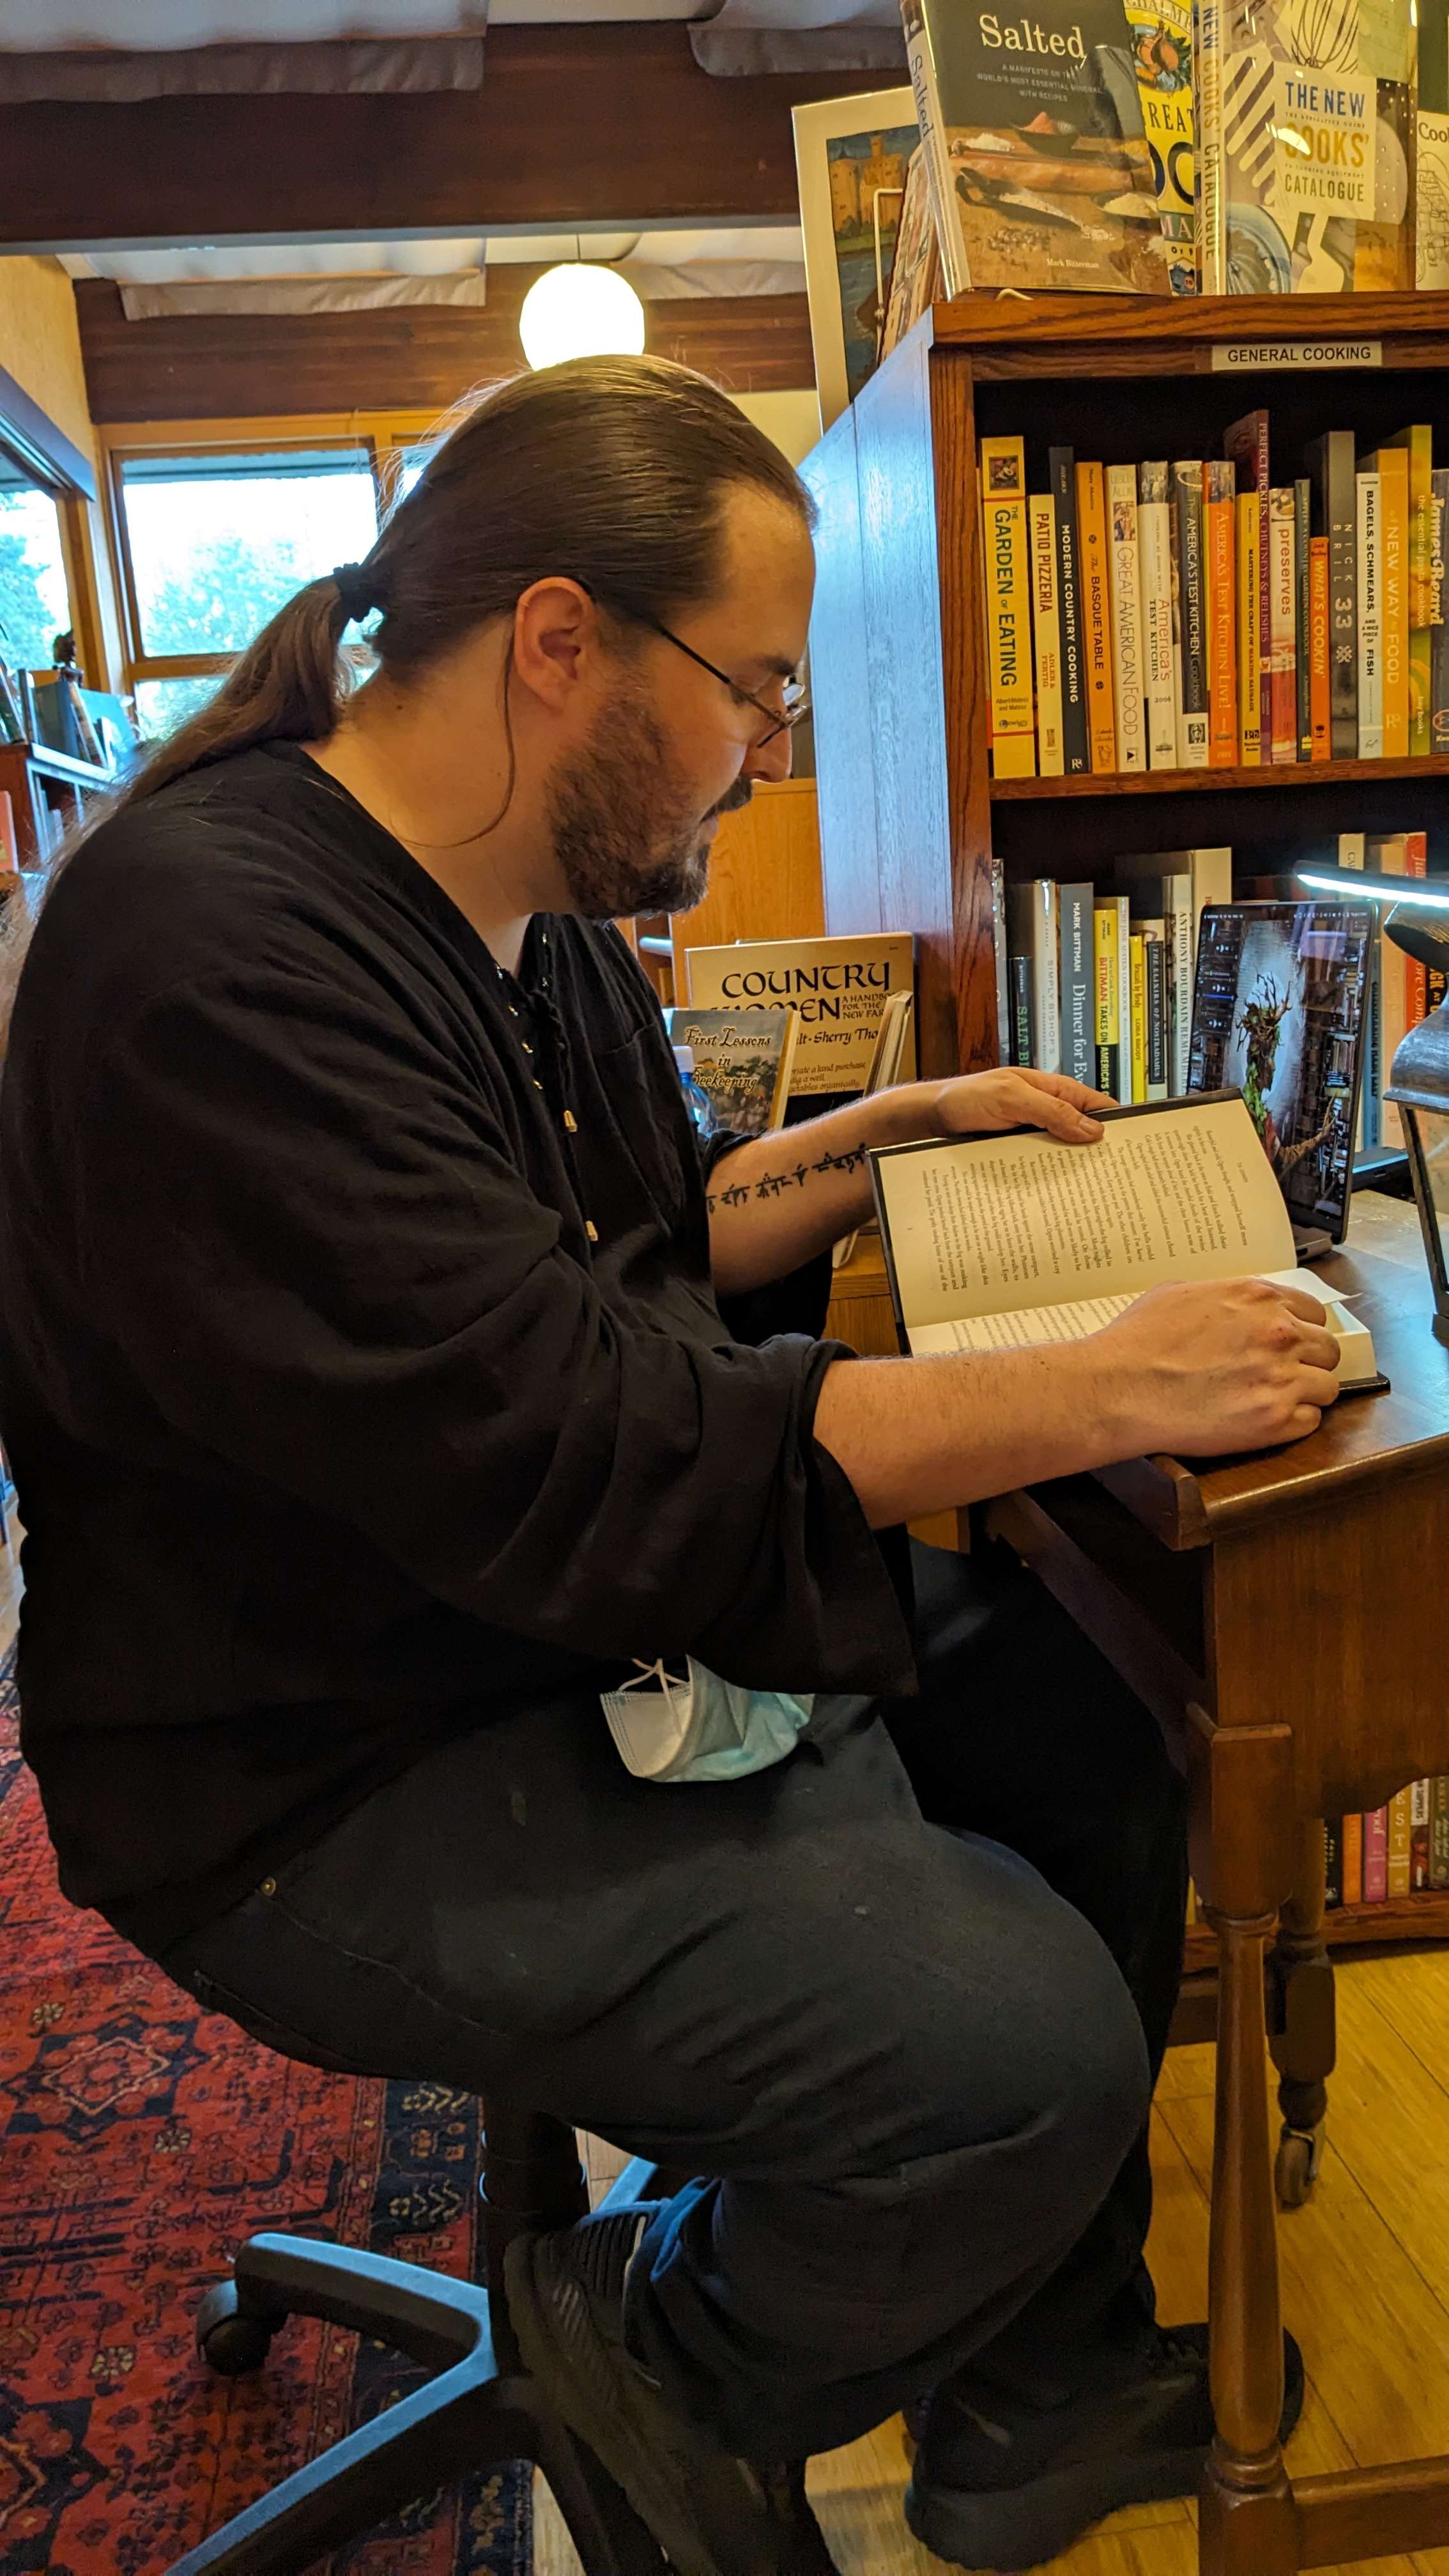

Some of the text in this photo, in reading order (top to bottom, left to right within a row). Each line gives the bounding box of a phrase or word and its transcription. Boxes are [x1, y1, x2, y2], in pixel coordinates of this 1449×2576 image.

[979, 14, 1085, 59] Salted
[1203, 7, 1218, 50] NEW
[976, 73, 1008, 83] WORLD'S
[1031, 79, 1070, 91] ESSENTIAL
[1009, 65, 1049, 76] MANIFESTO
[910, 55, 934, 137] Salted
[1019, 90, 1068, 102] WITH RECIPES
[1285, 81, 1365, 118] THE NEW
[1418, 122, 1449, 143] Coo
[1204, 143, 1221, 261] CATALOGUE
[1285, 173, 1365, 203] CATALOGUE
[1046, 258, 1100, 269] Mark Bitterman
[1227, 346, 1372, 362] GENERAL COOKING
[1011, 506, 1019, 521] THE
[1366, 490, 1375, 540] BAGELS,
[1259, 423, 1269, 643] PERFECT PICKLES, CHUTNEYS & RELISHES
[995, 509, 1014, 595] GARDEN
[1036, 513, 1053, 613] PATIO PIZZERIA
[1415, 494, 1427, 627] the essential pasta cookbook
[1430, 493, 1445, 625] James Beard
[1278, 528, 1291, 615] preserves
[1314, 561, 1325, 611] WHAT'S
[1367, 543, 1375, 613] SCHMEARS,
[1000, 600, 1008, 610] OF
[1061, 525, 1079, 703] MODERN COUNTRY COOKING
[1091, 576, 1102, 628] BASQUE
[1186, 518, 1200, 710] AMERICA'S TEST KITCHEN Cookbook
[1216, 512, 1231, 708] AMERICA'S TEST KITCHEN LIVE!
[1335, 597, 1353, 629] 33
[1387, 526, 1400, 684] NEW WAY FOOD
[998, 613, 1018, 686] EATING
[1094, 630, 1104, 670] TABLE
[1117, 547, 1139, 735] GREAT AMERICAN FOOD
[1158, 599, 1172, 680] America's
[1249, 636, 1254, 645] OF
[1314, 615, 1326, 678] COOKIN'
[1151, 632, 1159, 682] KITCHEN
[1073, 901, 1081, 930] MARK
[1073, 932, 1082, 972] BITTMAN
[1179, 911, 1188, 963] ANTHONY
[721, 962, 889, 998] COUNTRY
[1180, 967, 1189, 1023] BOURDAIN
[1433, 992, 1441, 1002] AT
[843, 1009, 884, 1020] NEW FAR
[850, 993, 890, 1002] HANDBO
[1073, 983, 1087, 1036] Dinner
[1133, 993, 1143, 1008] Brody
[1154, 1008, 1161, 1017] OF
[685, 1025, 772, 1047] First Lessons
[854, 1028, 879, 1041] Tho
[1017, 1006, 1029, 1045] SALT
[1048, 1002, 1056, 1055] BISHOP'S
[1100, 957, 1110, 1089] BITTMAN TAKES ON AMERICA'S
[717, 1054, 731, 1066] in
[1073, 1039, 1087, 1059] for
[817, 1061, 867, 1073] land purchase
[1048, 1241, 1060, 1260] worried
[1068, 1243, 1080, 1256] likely
[1081, 1244, 1089, 1253] On
[1090, 1238, 1101, 1268] Most nights
[1102, 1244, 1112, 1260] rolled
[1121, 1233, 1132, 1254] children
[1145, 1244, 1154, 1260] could
[1218, 1235, 1229, 1249] their
[951, 1279, 960, 1289] and
[1000, 1268, 1011, 1282] Eyes
[1052, 1265, 1060, 1274] cry
